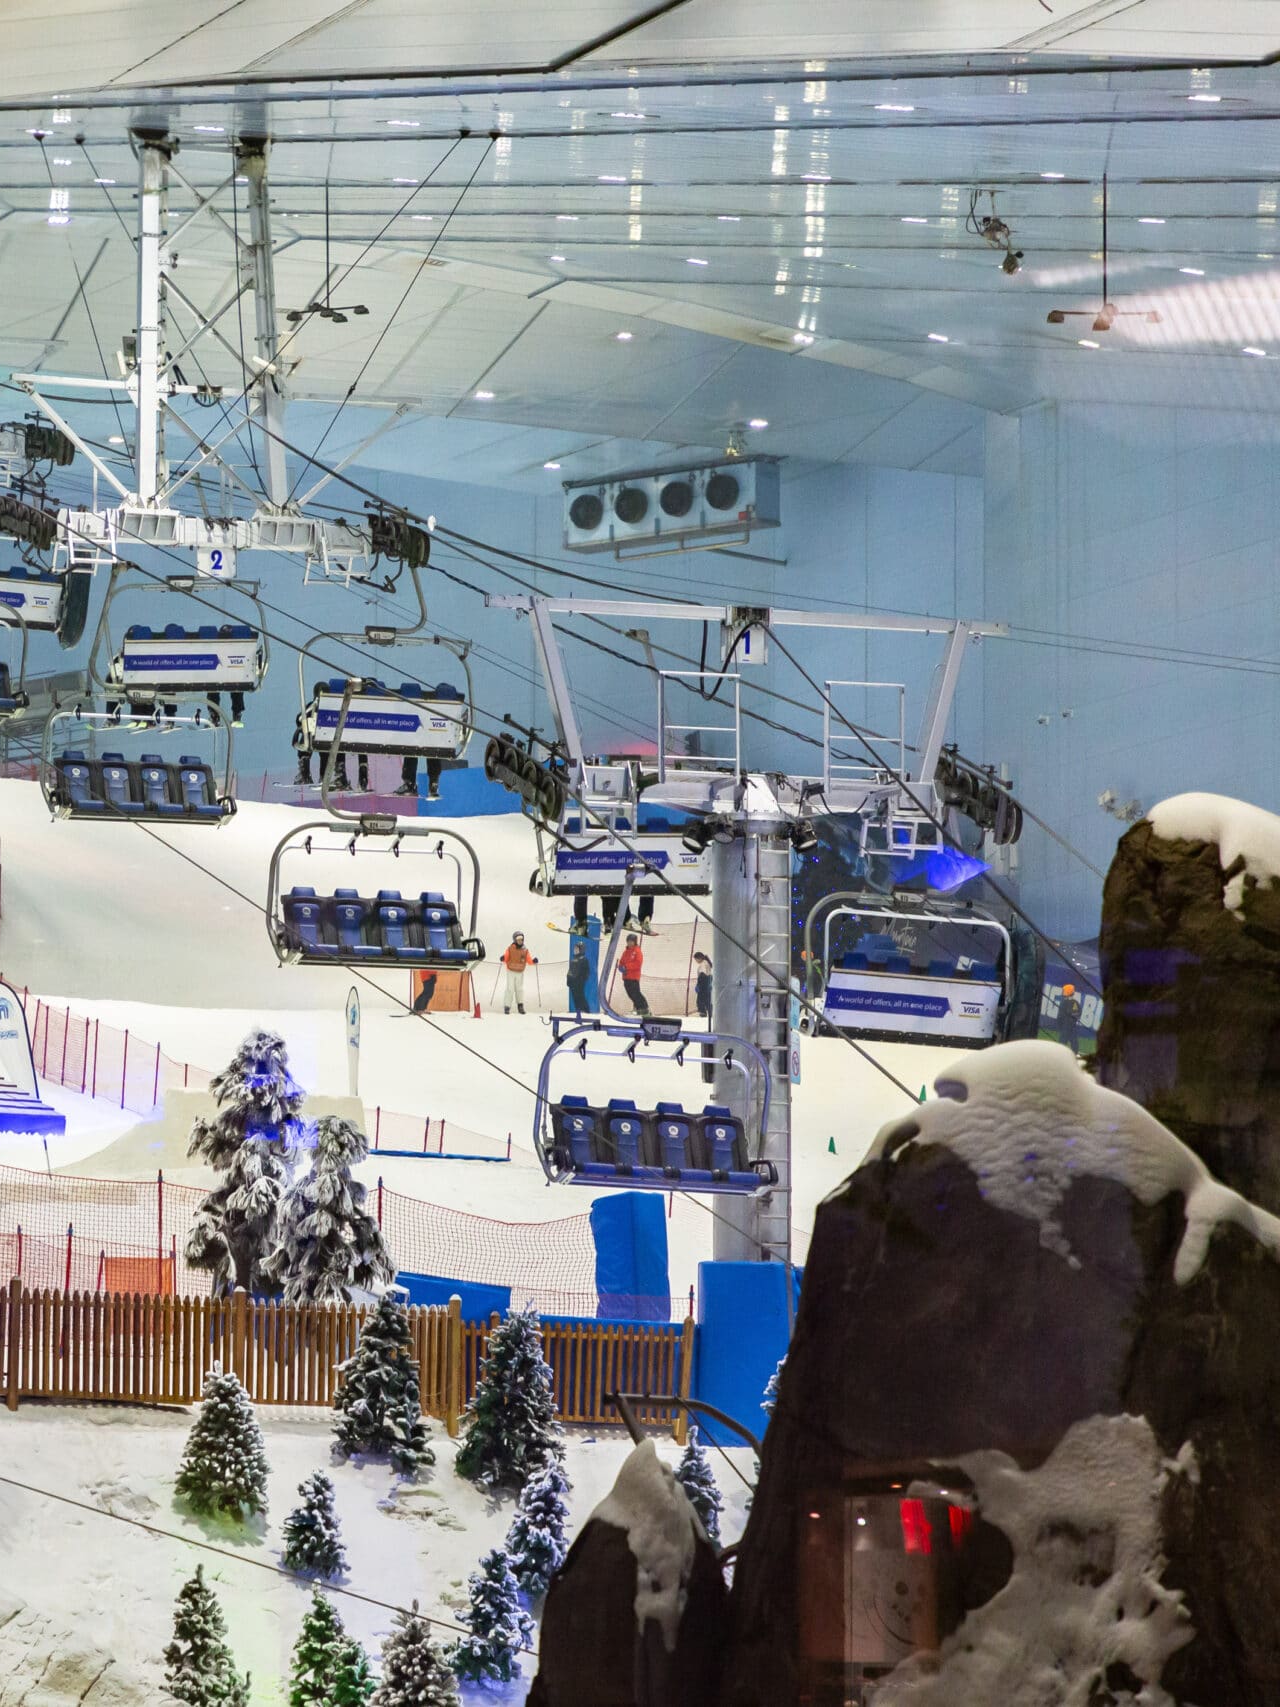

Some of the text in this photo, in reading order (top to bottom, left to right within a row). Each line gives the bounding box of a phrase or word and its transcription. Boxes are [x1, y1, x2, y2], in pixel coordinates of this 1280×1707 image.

[211, 549, 223, 570] 2
[741, 629, 751, 655] 1
[924, 1003, 942, 1011] place
[963, 1006, 980, 1014] VISA
